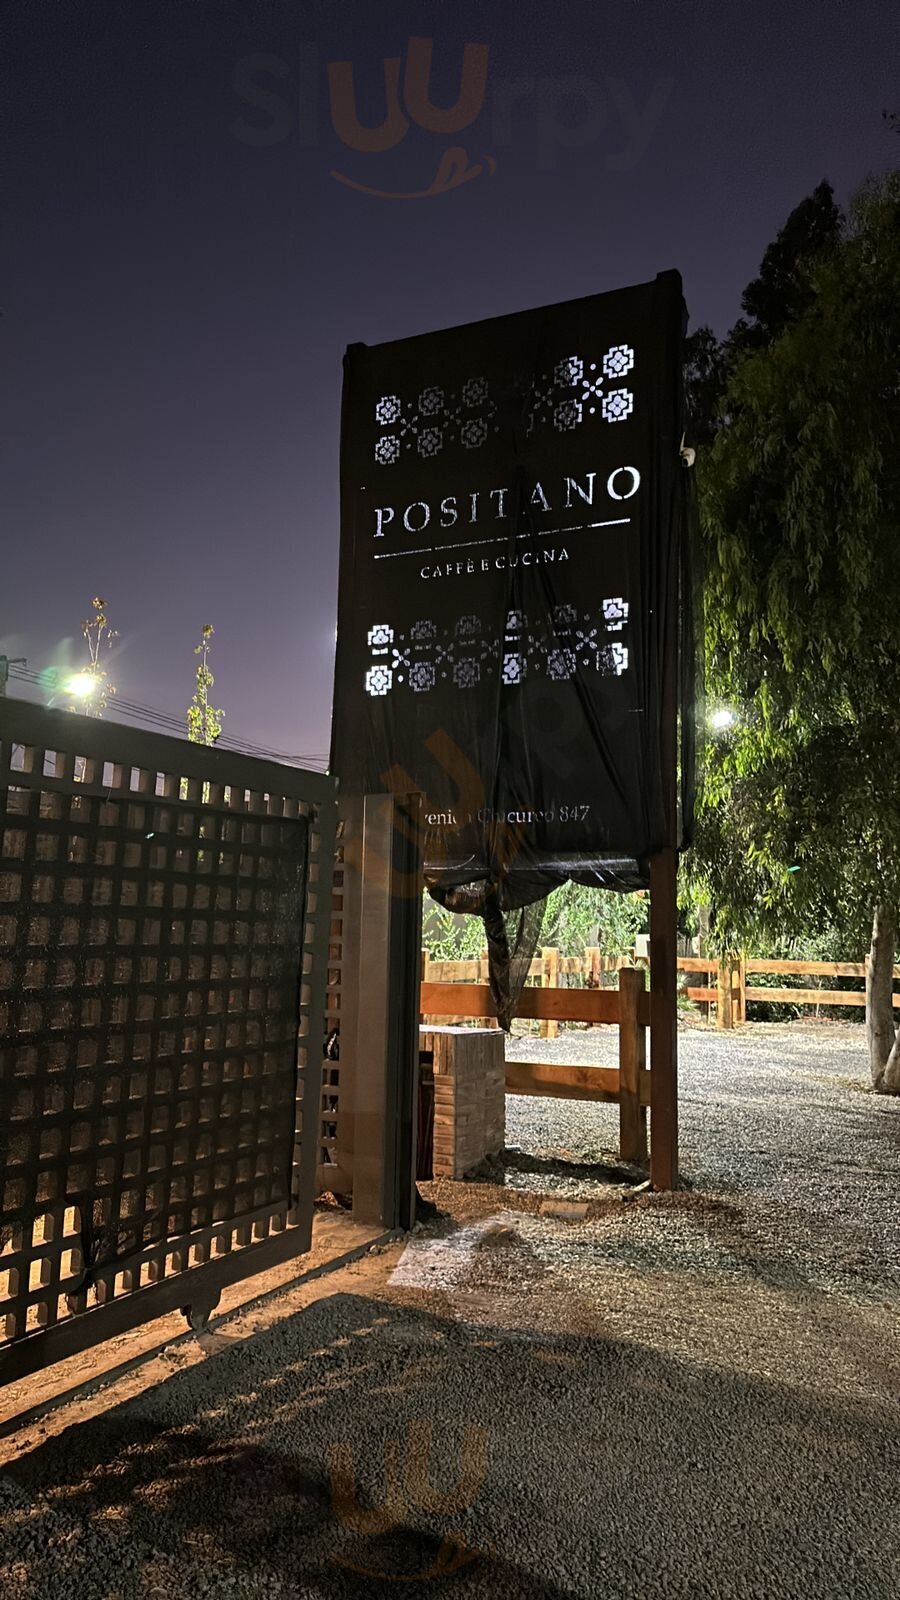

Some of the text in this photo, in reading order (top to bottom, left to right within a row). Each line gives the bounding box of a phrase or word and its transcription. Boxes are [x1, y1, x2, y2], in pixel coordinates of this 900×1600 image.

[373, 465, 641, 538] POSITANO
[481, 558, 490, 572] E
[495, 547, 570, 568] CUCINA
[559, 805, 591, 823] 847
